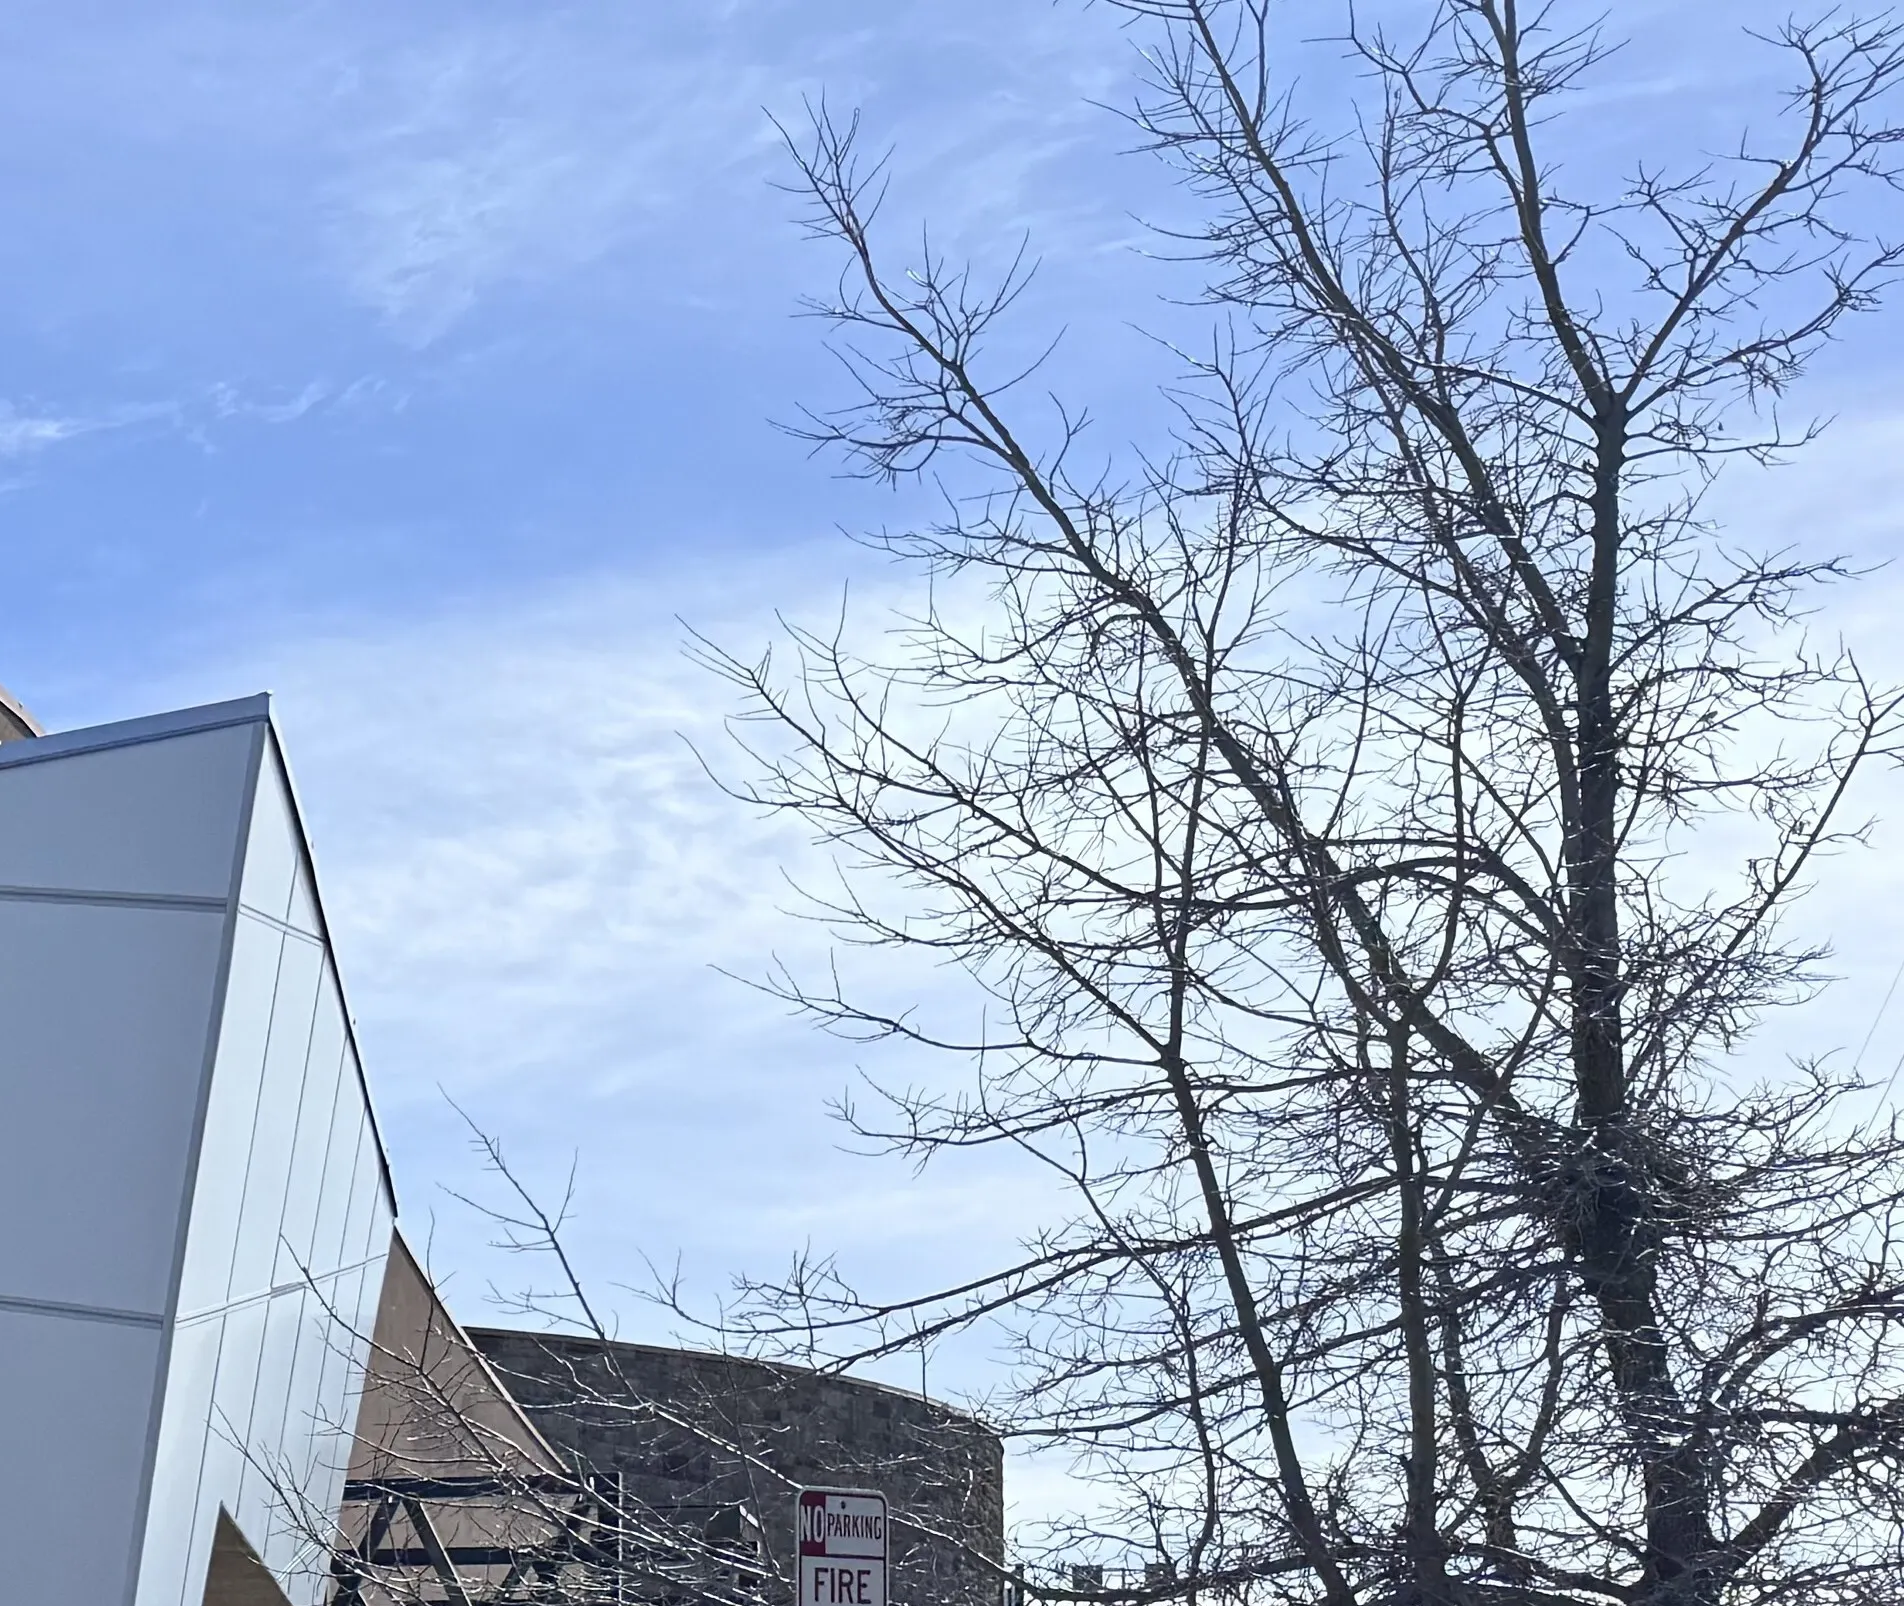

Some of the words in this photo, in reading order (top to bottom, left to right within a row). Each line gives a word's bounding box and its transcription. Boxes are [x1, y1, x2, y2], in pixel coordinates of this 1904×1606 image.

[800, 1504, 825, 1543] NO
[827, 1512, 882, 1540] PARKING
[814, 1567, 872, 1605] FIRE
